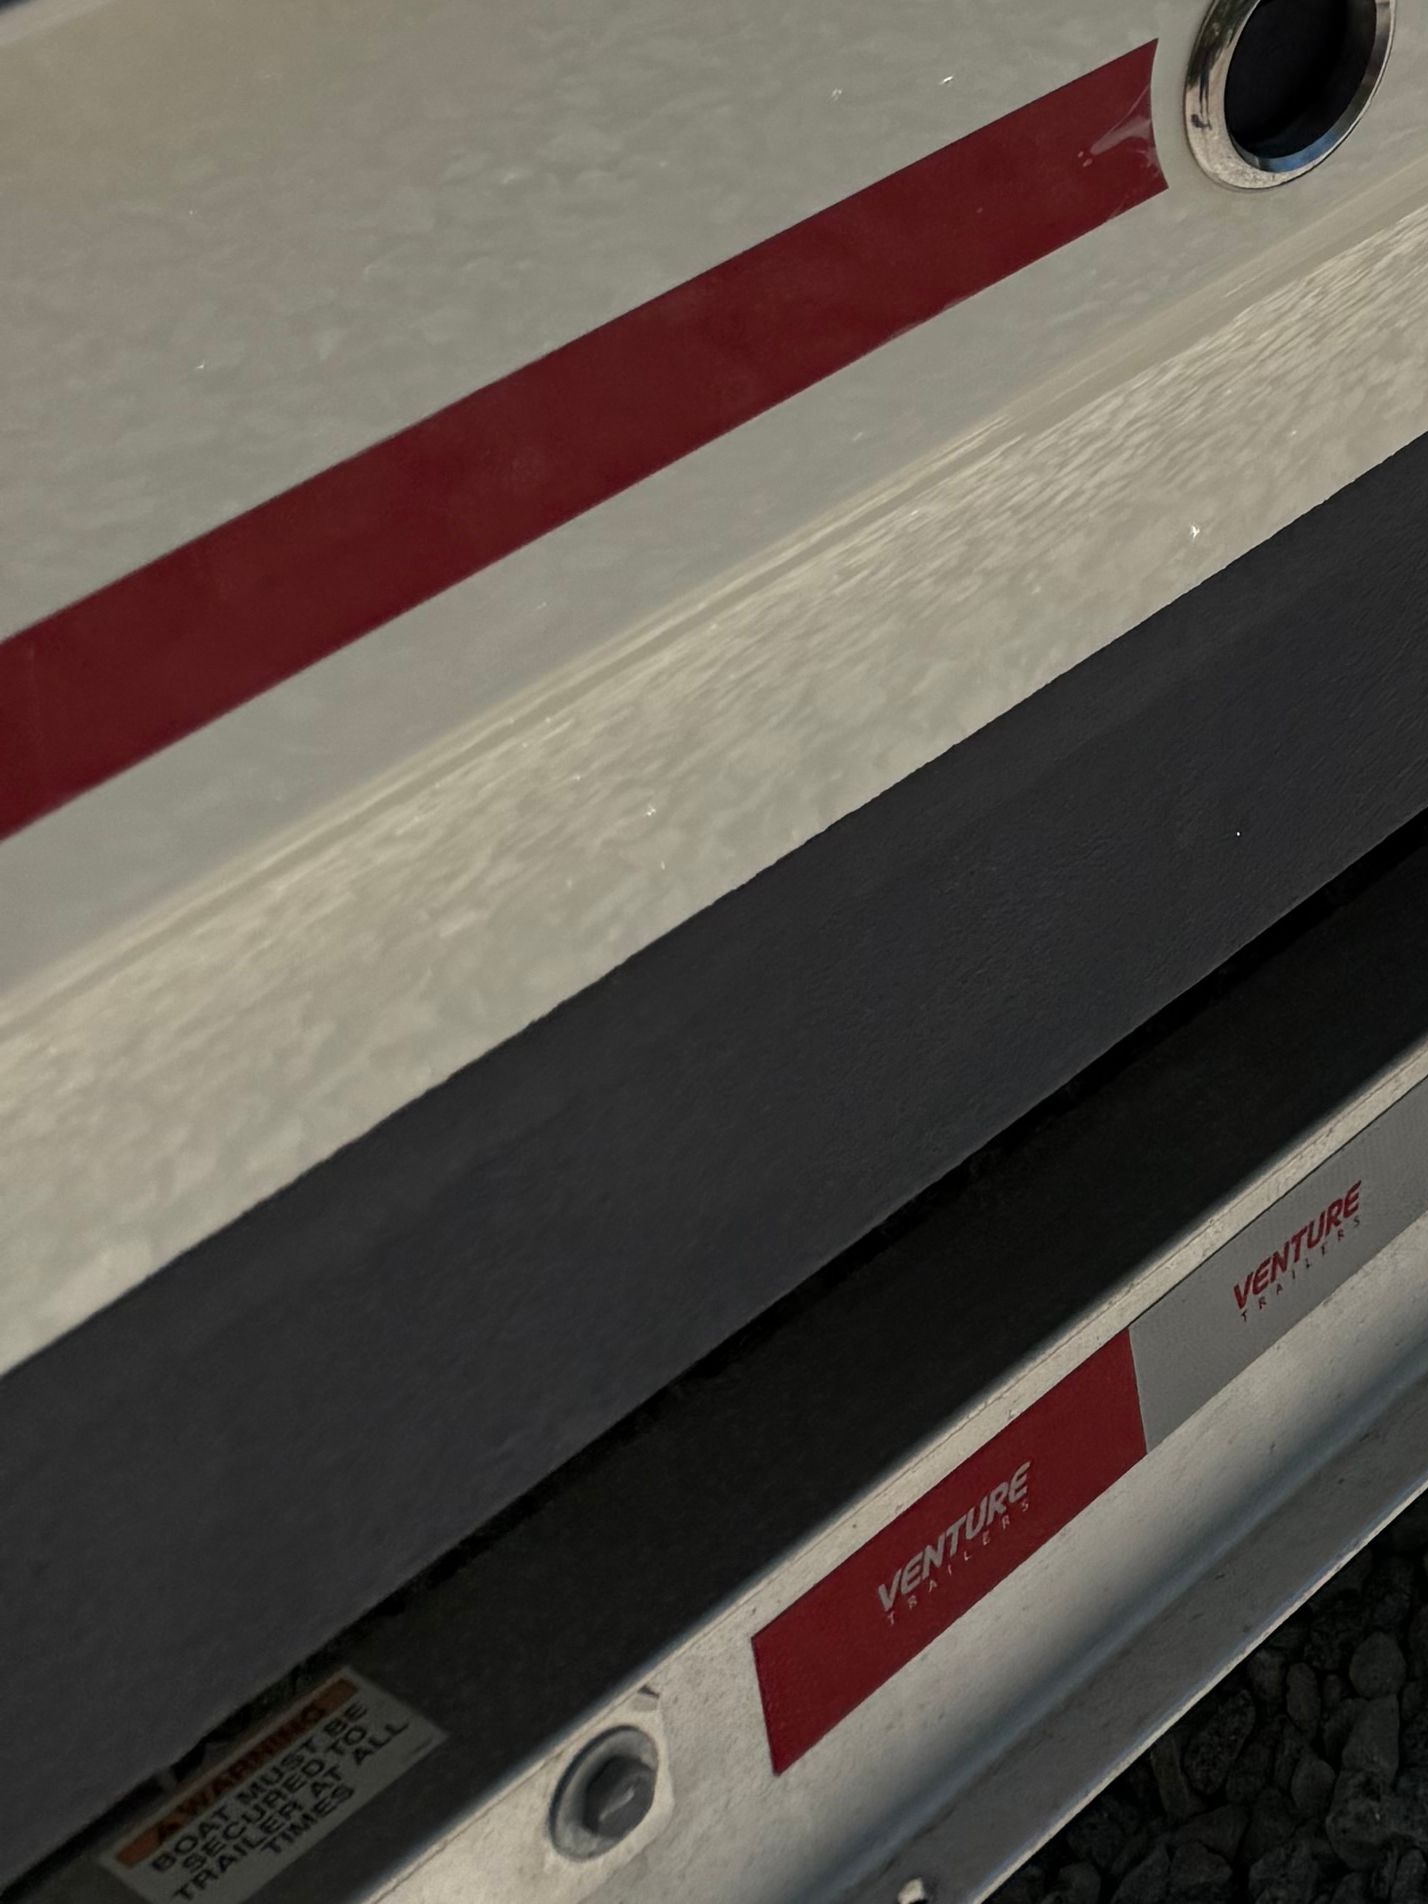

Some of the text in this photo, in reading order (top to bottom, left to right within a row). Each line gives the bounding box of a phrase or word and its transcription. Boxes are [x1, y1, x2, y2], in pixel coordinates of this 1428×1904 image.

[1233, 1179, 1362, 1310] VENTURE
[877, 1461, 1032, 1613] VENTURE
[152, 1701, 369, 1873] BOAT MUST BE
[172, 1801, 304, 1903] TRAILER
[310, 1766, 344, 1799] AT
[352, 1720, 411, 1767] ALL
[177, 1704, 327, 1819] WARNING
[182, 1723, 368, 1874] SECURED TO
[261, 1786, 356, 1857] TIMES
